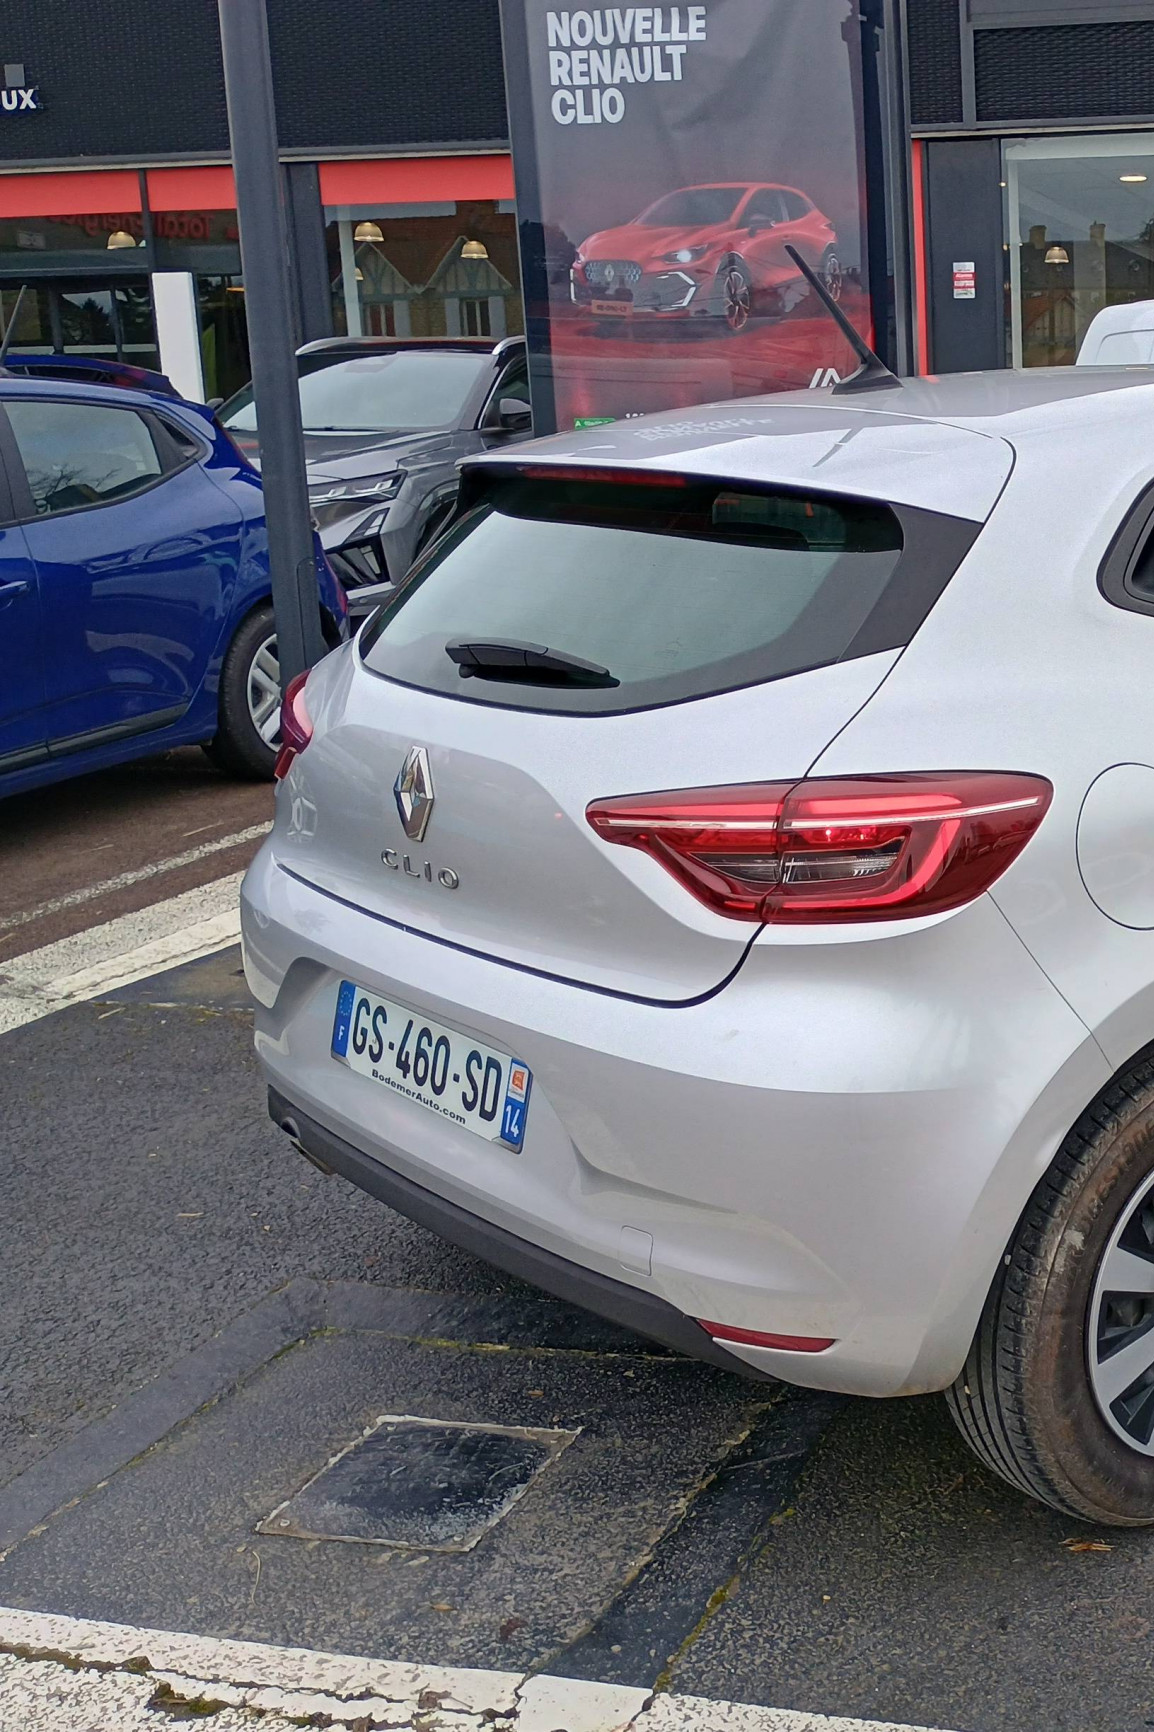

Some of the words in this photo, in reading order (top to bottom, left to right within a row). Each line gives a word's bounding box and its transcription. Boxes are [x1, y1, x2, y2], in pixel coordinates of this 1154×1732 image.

[546, 6, 706, 46] NOUVELLE
[549, 44, 687, 86] RENAULT
[1, 89, 37, 111] UX
[551, 87, 625, 125] CLIO
[381, 848, 459, 889] CLIO
[338, 1025, 345, 1040] F
[352, 997, 503, 1123] GS-460-SD
[371, 1068, 467, 1125] BodemerAuto.com
[505, 1104, 521, 1138] 14
